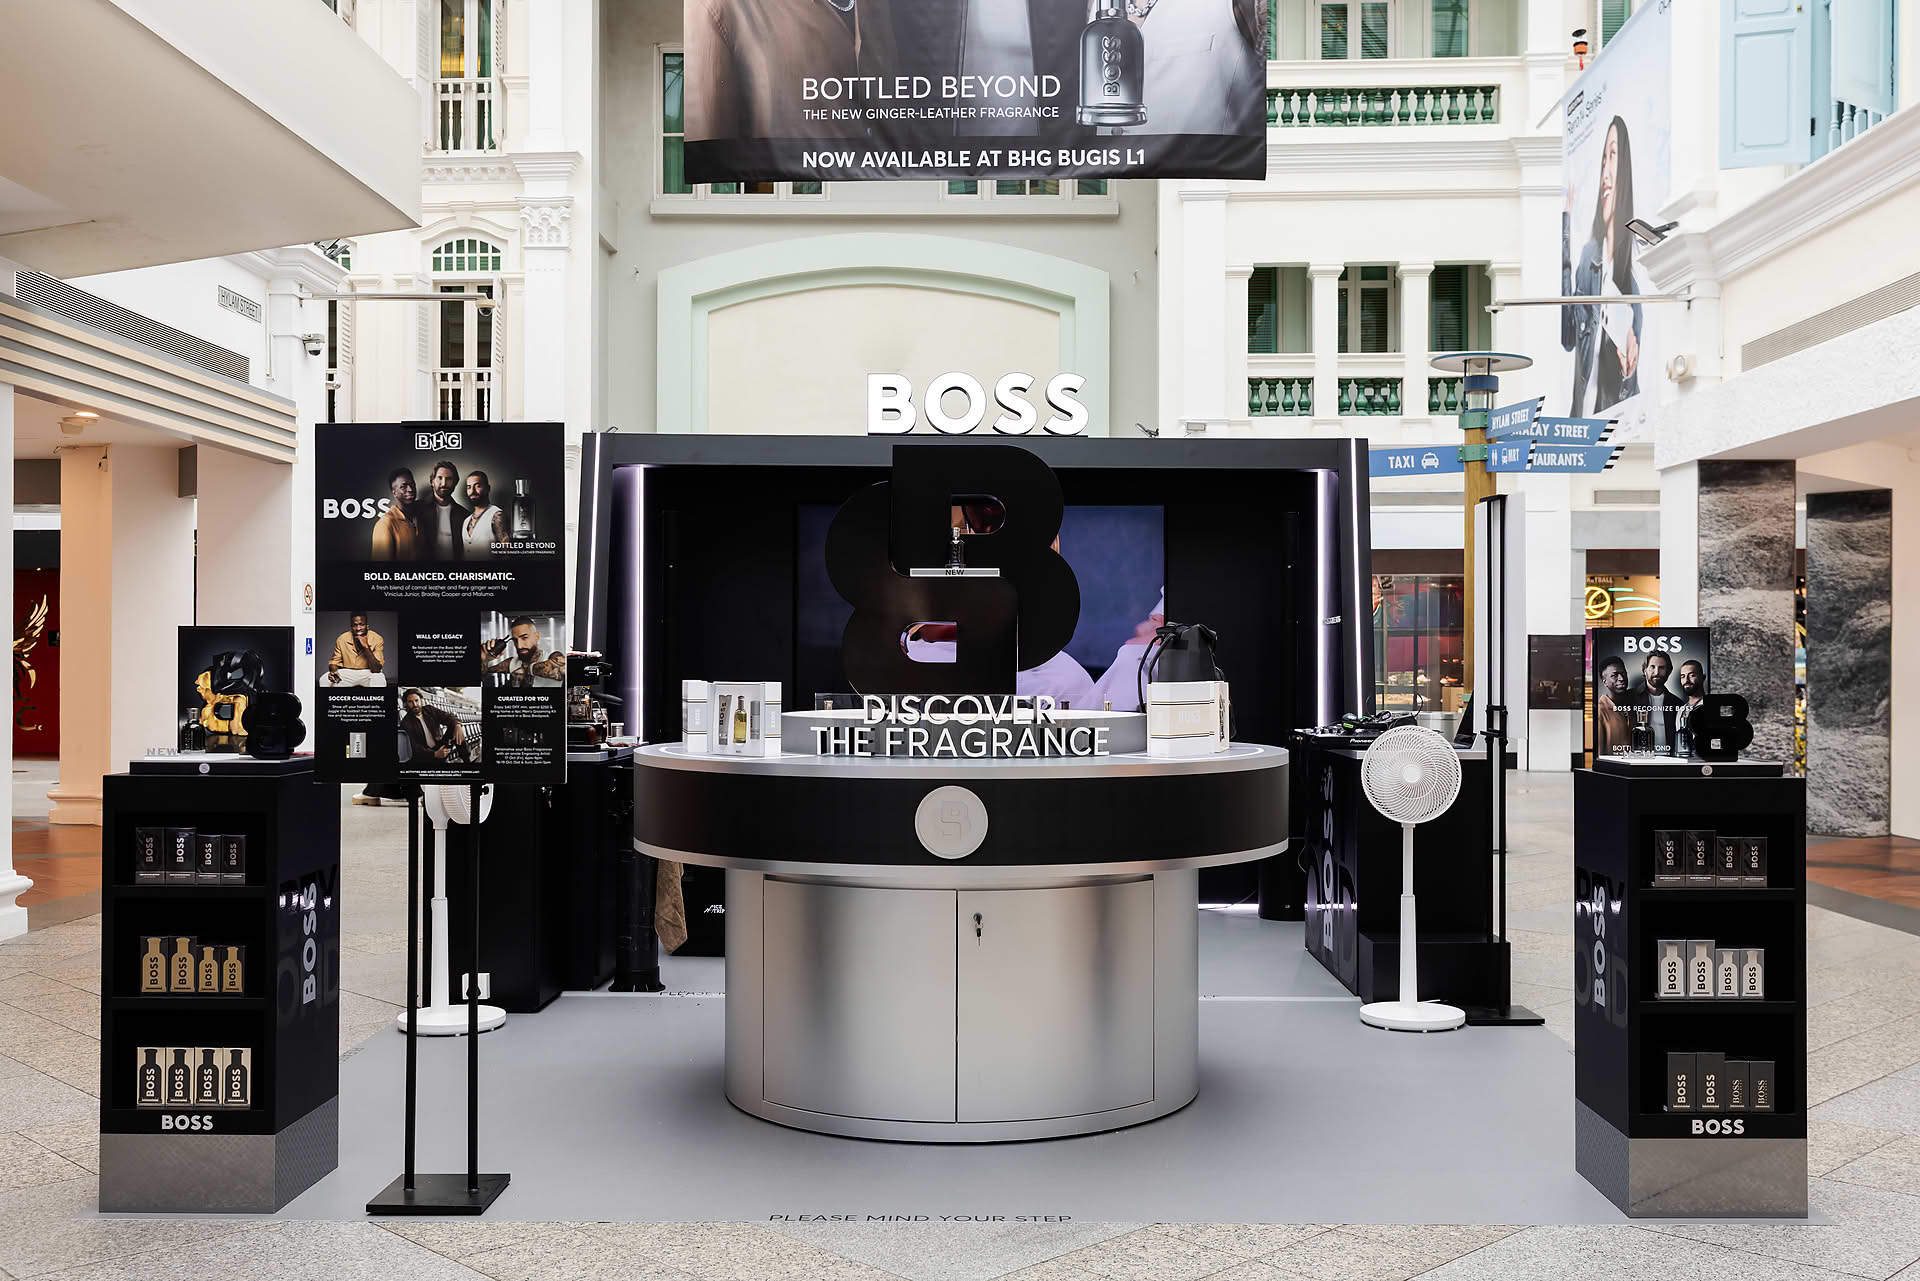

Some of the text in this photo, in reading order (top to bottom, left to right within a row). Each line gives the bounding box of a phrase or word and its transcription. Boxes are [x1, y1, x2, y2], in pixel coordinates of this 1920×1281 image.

[1102, 36, 1121, 96] BOSS
[803, 75, 1060, 100] BOTTLED BEYOND
[804, 106, 1059, 120] THE NEW GINGER-LEATHER FRAGRANCE
[803, 149, 1145, 168] NOW AVAILABLE AT BHG BUGIS L1
[221, 290, 258, 318] HYLAM STREET
[867, 371, 1089, 436] BOSS
[1491, 408, 1529, 430] HYLAM STREET
[1512, 424, 1589, 439] ALAY STREET
[416, 432, 461, 450] BHG
[1388, 455, 1414, 469] TAXI
[1533, 452, 1585, 466] TAURANTS
[323, 498, 391, 519] BOSS
[364, 572, 515, 580] BOLD. BALANCED. CHARISMATIC.
[1624, 636, 1682, 653] BOSS
[864, 695, 1056, 725] DISCOVER
[146, 748, 178, 756] NEW
[810, 726, 1110, 758] THE FRAGRANCE
[303, 882, 317, 1004] BOSS
[1594, 885, 1606, 1007] BOSS
[150, 956, 158, 985] BOSS
[179, 956, 187, 985] BOSS
[1668, 961, 1676, 990] BOSS
[1697, 961, 1706, 990] BOSS
[146, 1068, 155, 1097] BOSS
[175, 1068, 183, 1097] BOSS
[204, 1068, 212, 1097] BOSS
[232, 1068, 240, 1097] BOSS
[1677, 1074, 1686, 1103] BOSS
[1706, 1074, 1715, 1103] BOSS
[161, 1115, 214, 1130] BOSS
[1692, 1119, 1745, 1135] BOSS
